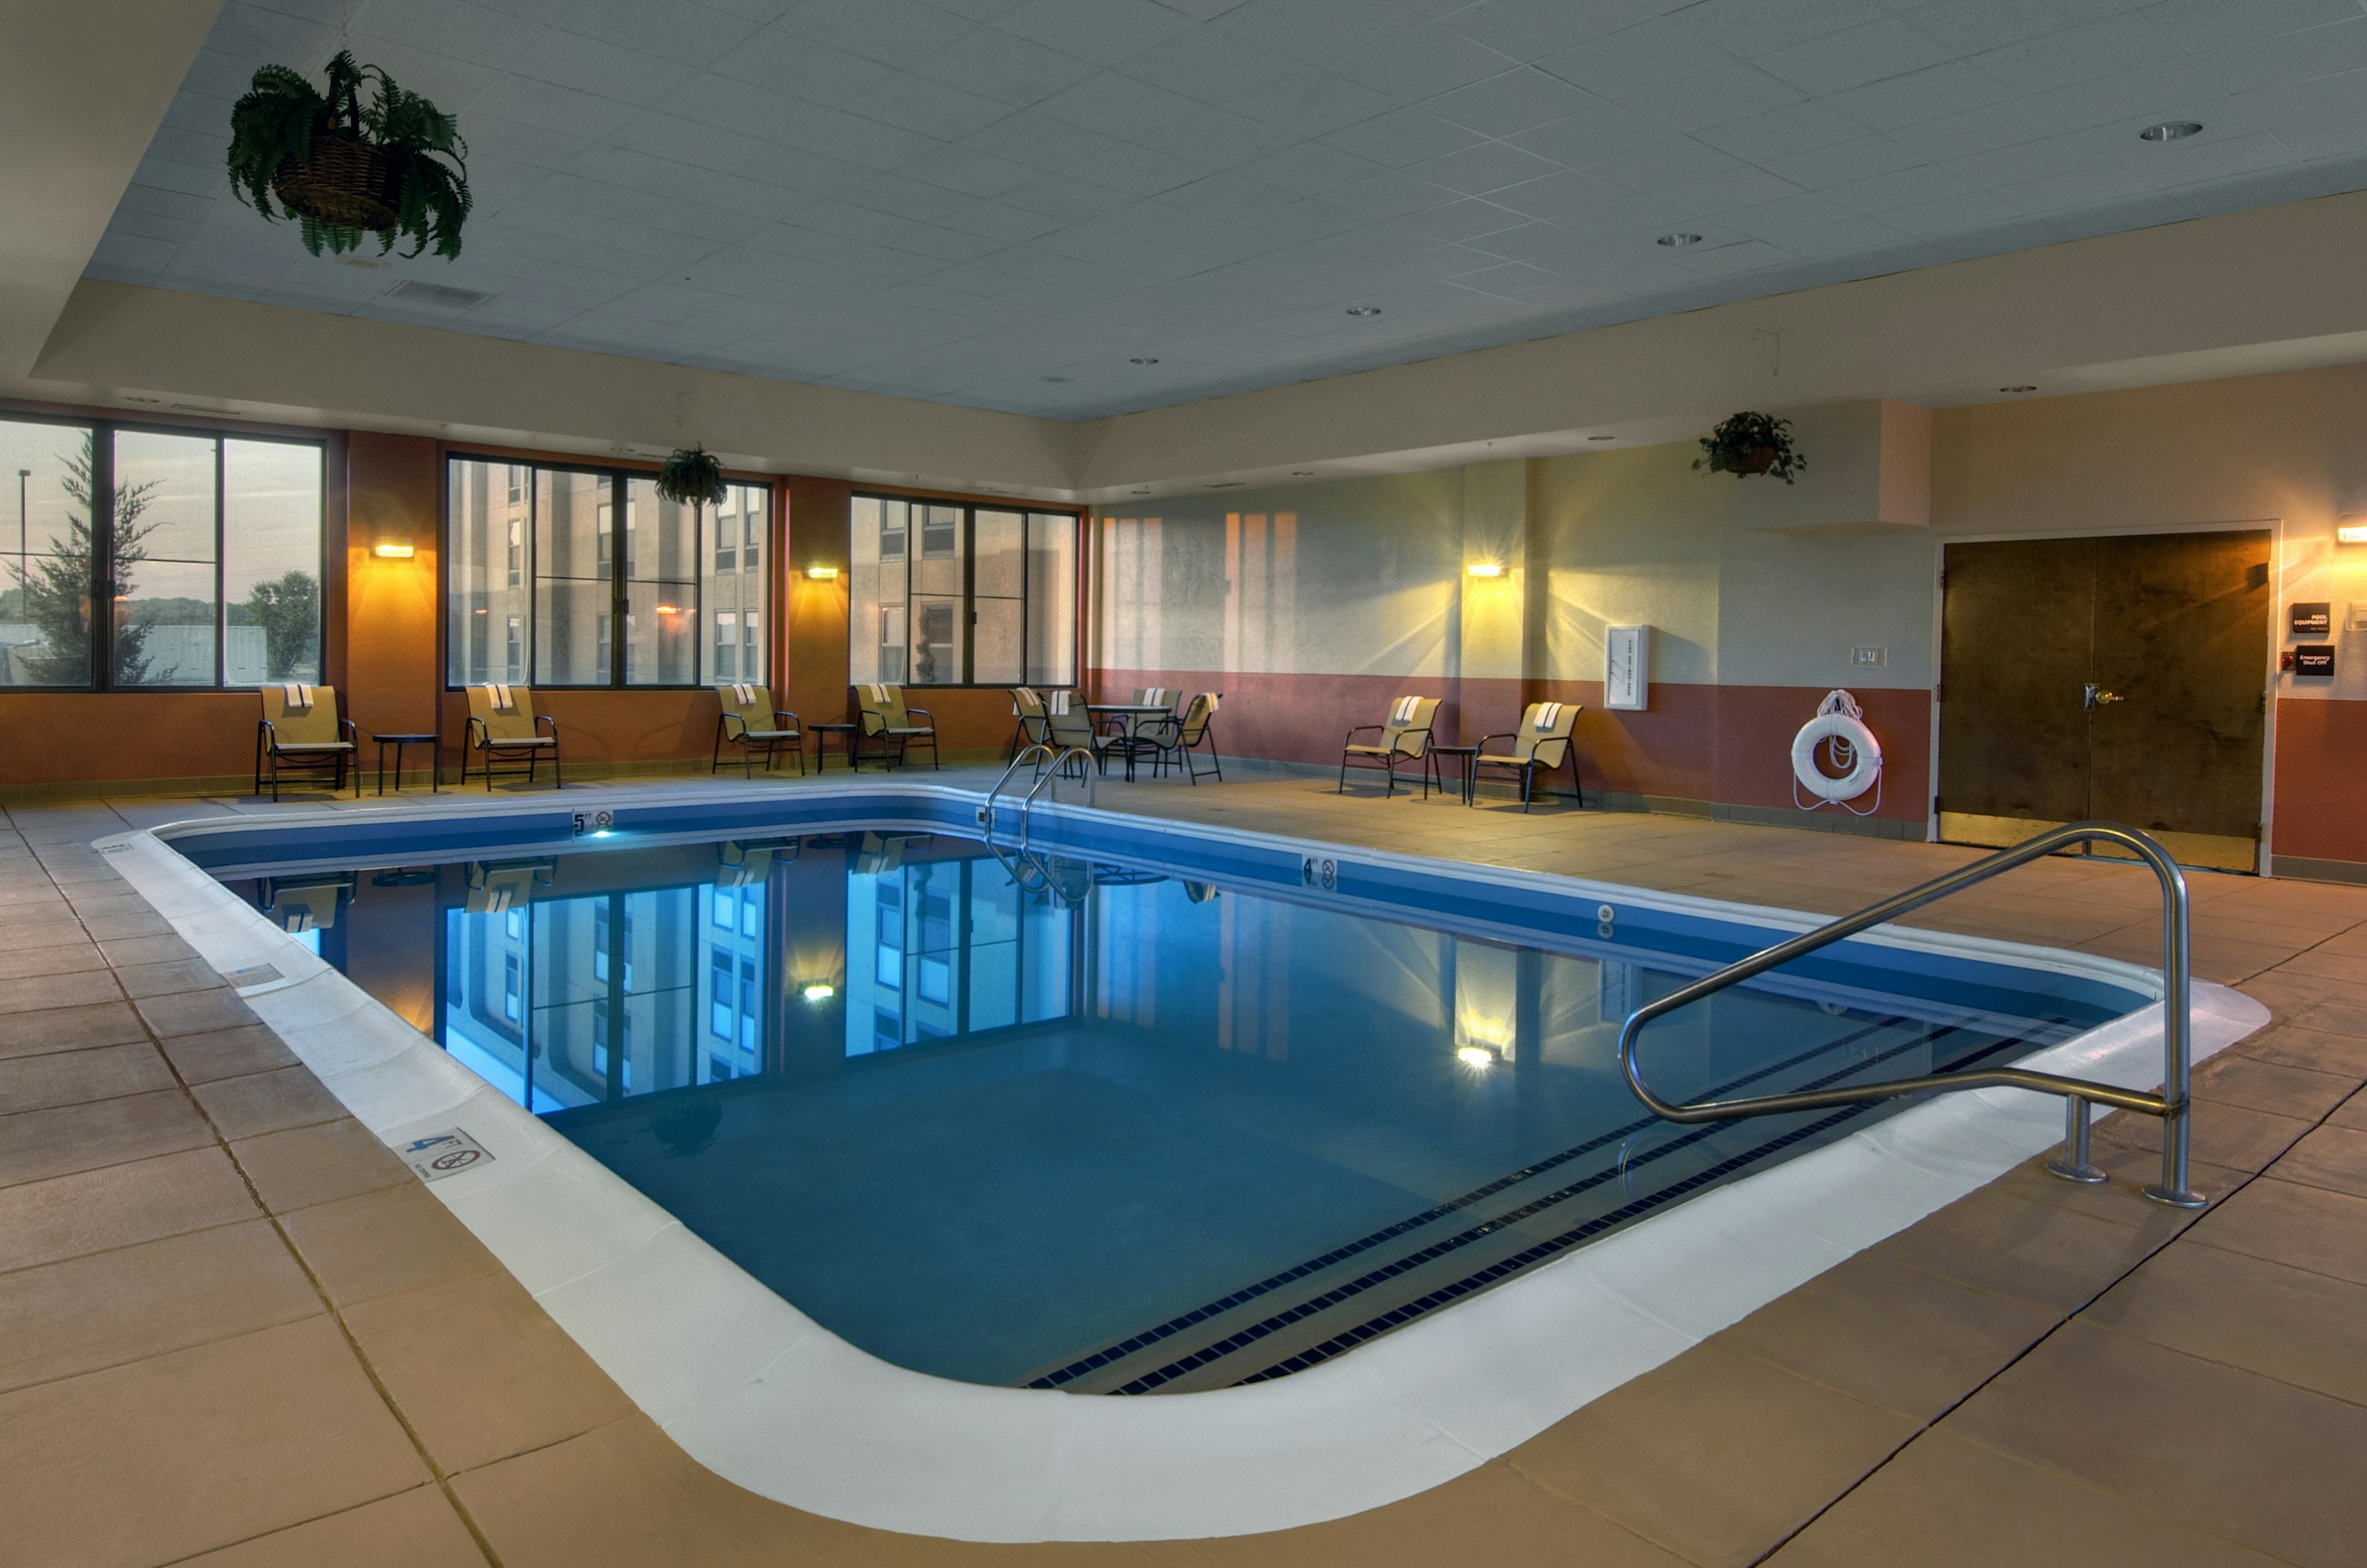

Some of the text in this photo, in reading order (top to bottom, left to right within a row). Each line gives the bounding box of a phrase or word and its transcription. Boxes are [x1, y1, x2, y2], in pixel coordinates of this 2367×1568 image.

[1304, 858, 1312, 872] 4
[406, 1135, 462, 1152] 4 FT
